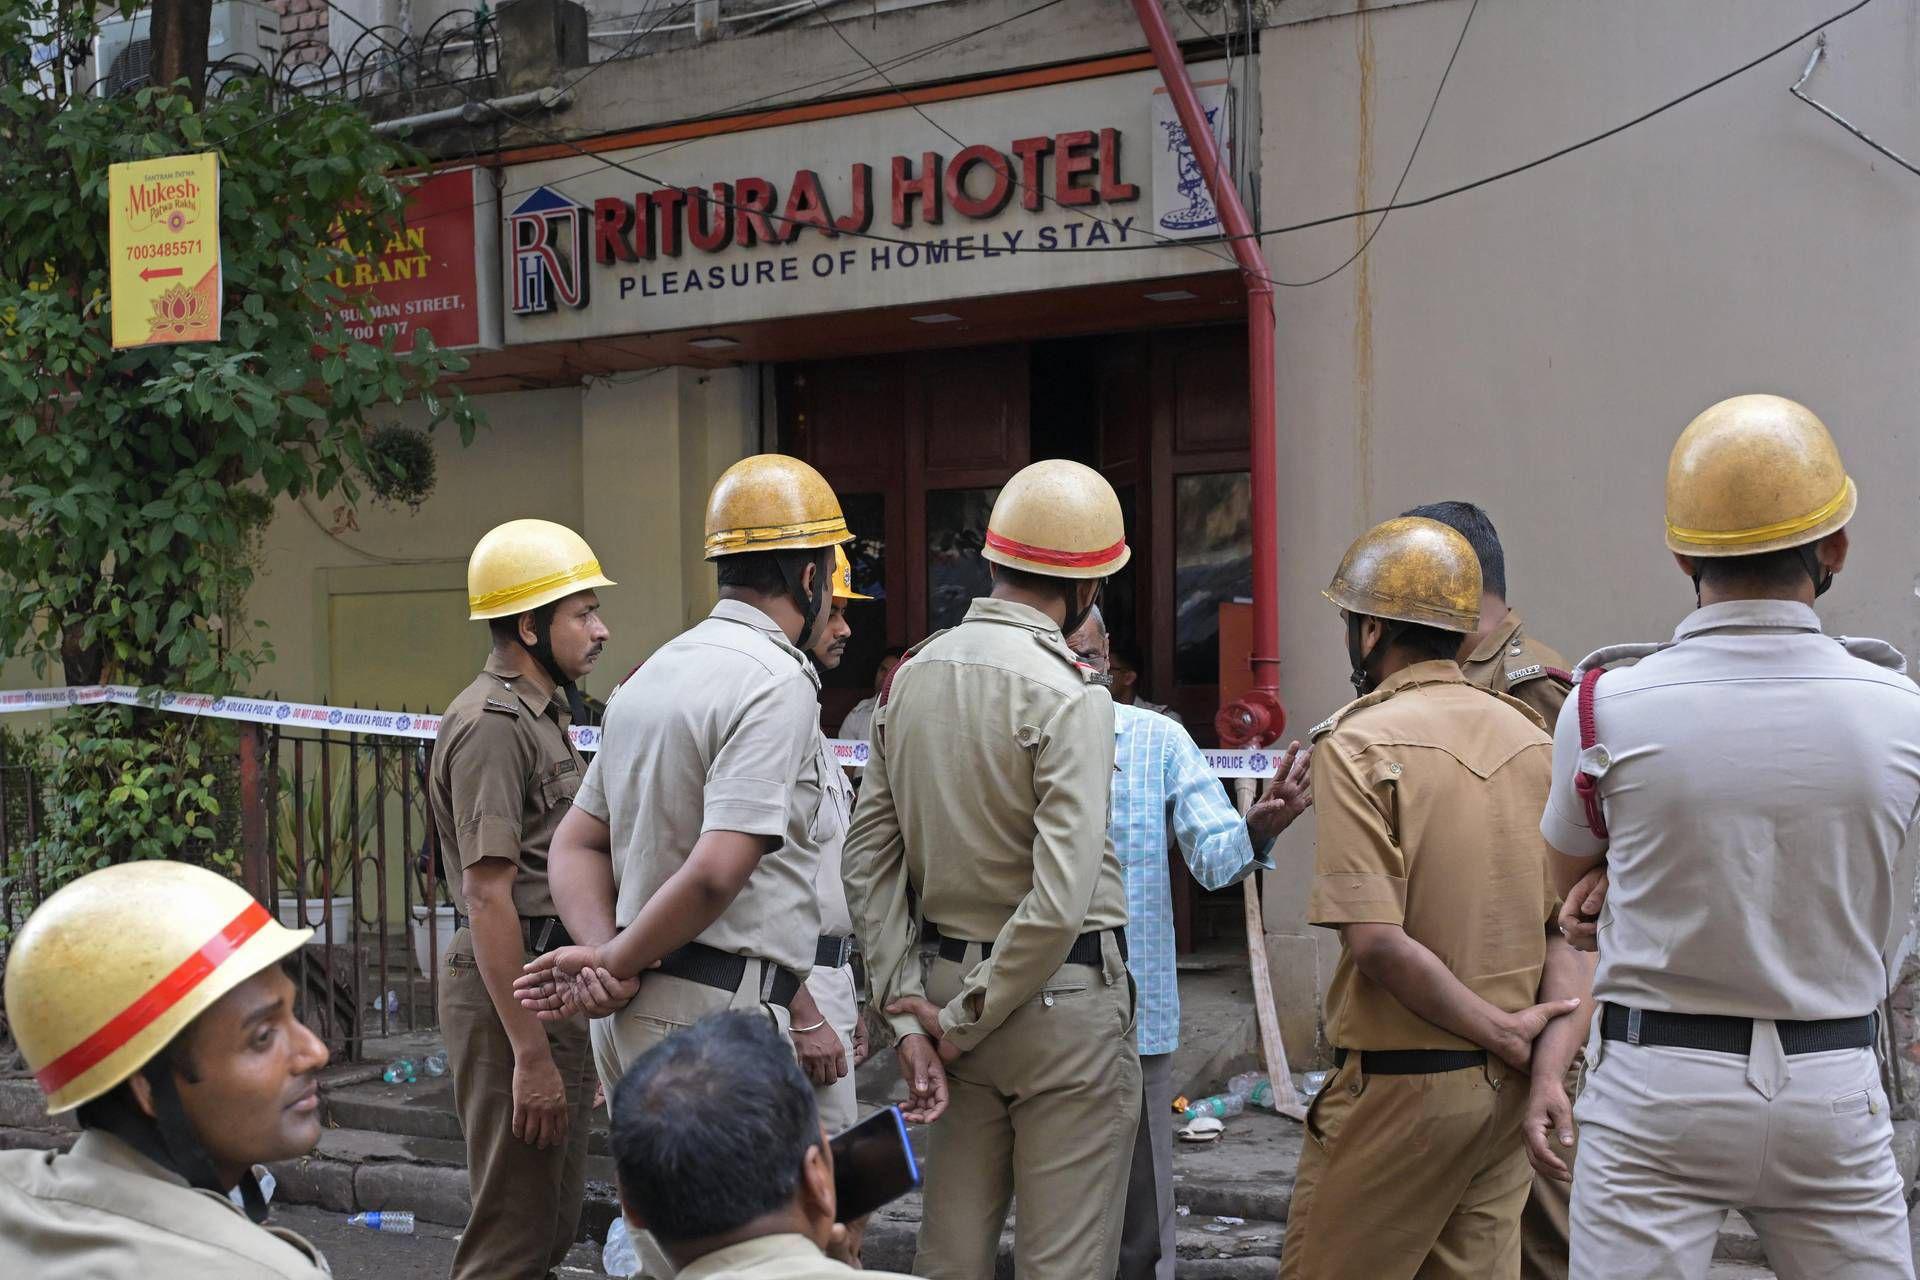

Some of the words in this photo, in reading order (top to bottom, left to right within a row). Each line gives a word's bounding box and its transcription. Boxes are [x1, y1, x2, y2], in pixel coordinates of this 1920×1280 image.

[129, 178, 197, 220] Mukesh
[594, 163, 872, 265] RITURAJ
[891, 127, 1140, 230] HOTEL
[126, 239, 202, 261] 7003485571
[619, 257, 799, 299] PLEASURE
[811, 250, 857, 278] OF
[870, 229, 1024, 271] HOMELY
[1037, 216, 1135, 251] STAY
[340, 303, 400, 322] BUMAN
[405, 295, 465, 314] STREET,
[253, 704, 274, 715] POLICE
[343, 713, 371, 725] KOLKATA
[371, 715, 393, 728] POLICE
[833, 745, 853, 758] CROSS
[1216, 756, 1243, 769] POLICE
